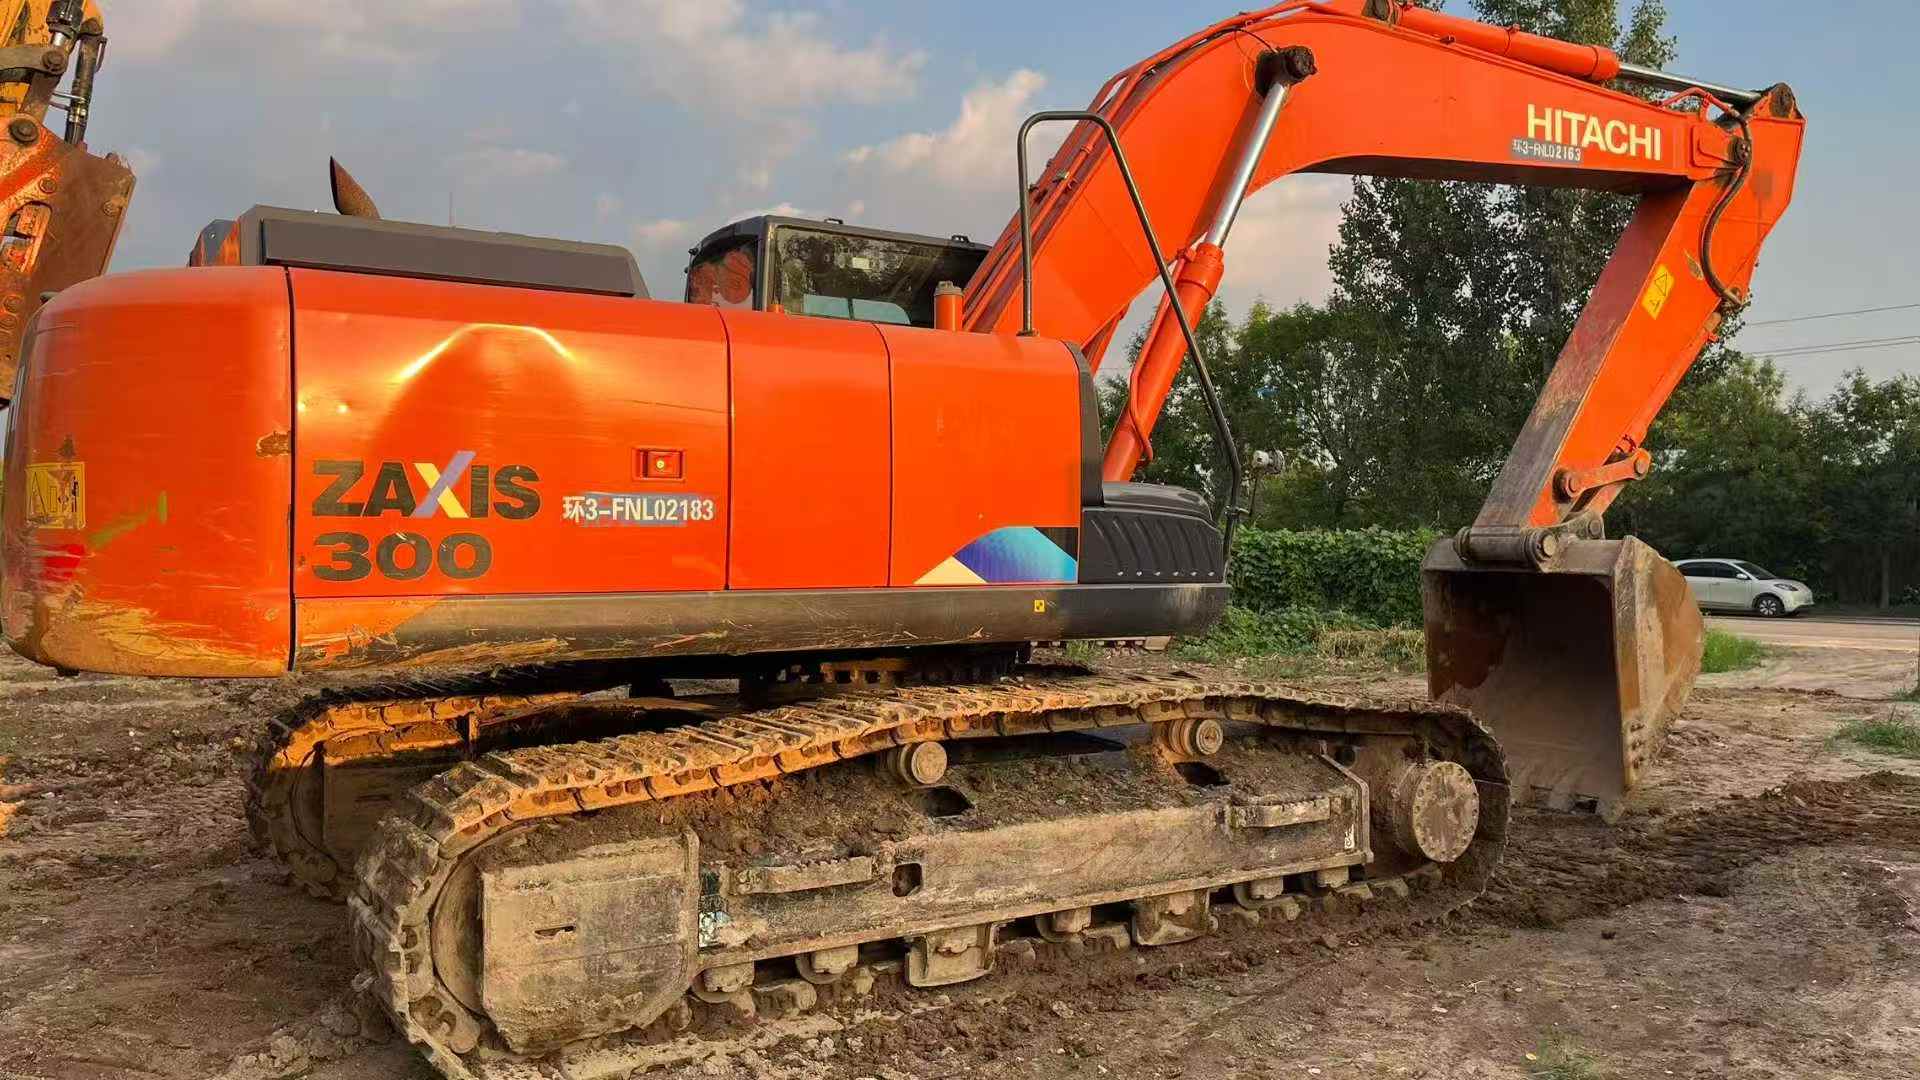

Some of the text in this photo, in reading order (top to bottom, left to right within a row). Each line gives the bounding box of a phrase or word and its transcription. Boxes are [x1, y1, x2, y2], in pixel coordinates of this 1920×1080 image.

[1527, 104, 1661, 161] HITACHI
[312, 451, 541, 519] ZAXIS
[562, 495, 715, 523] 环3-FNL02183
[312, 532, 492, 581] 300
